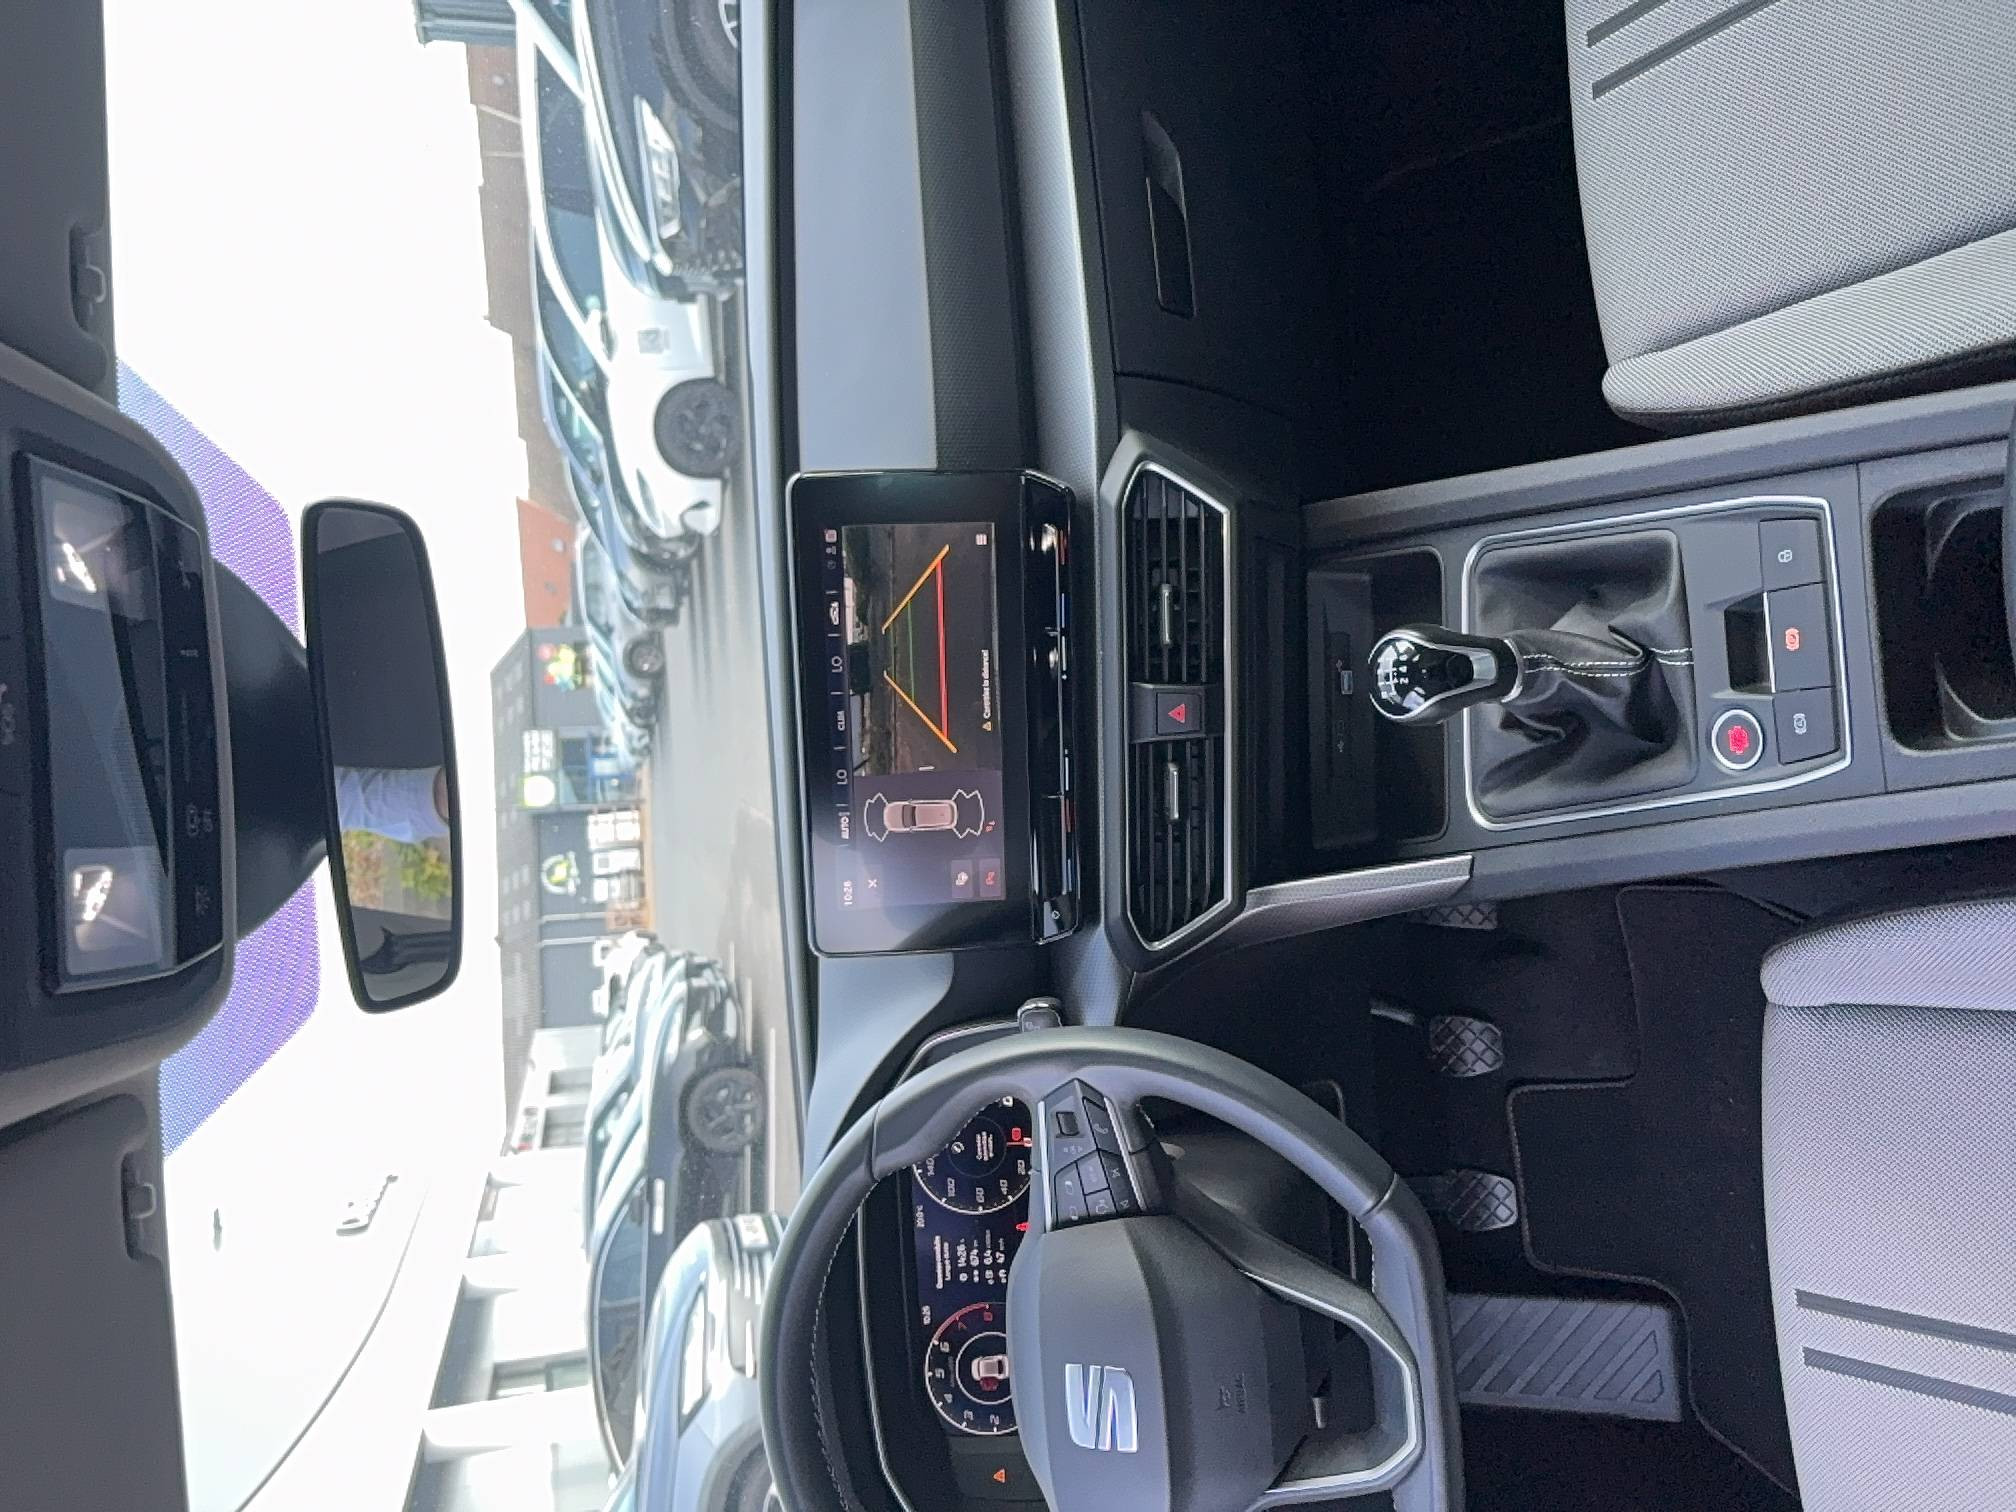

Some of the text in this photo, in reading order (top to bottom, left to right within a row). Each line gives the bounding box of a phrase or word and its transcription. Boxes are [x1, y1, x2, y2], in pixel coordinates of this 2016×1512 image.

[831, 656, 842, 672] LO
[836, 768, 848, 785] LO
[840, 816, 850, 839] AUTO
[926, 1158, 934, 1176] 140
[1018, 1160, 1026, 1176] 20
[947, 1178, 956, 1197] 100
[976, 1187, 984, 1203] 60
[1000, 1179, 1008, 1195] 40
[940, 1342, 950, 1352] 6
[935, 1368, 944, 1379] 5
[944, 1394, 952, 1404] 4
[964, 1410, 974, 1420] 3
[990, 1414, 1000, 1425] 2
